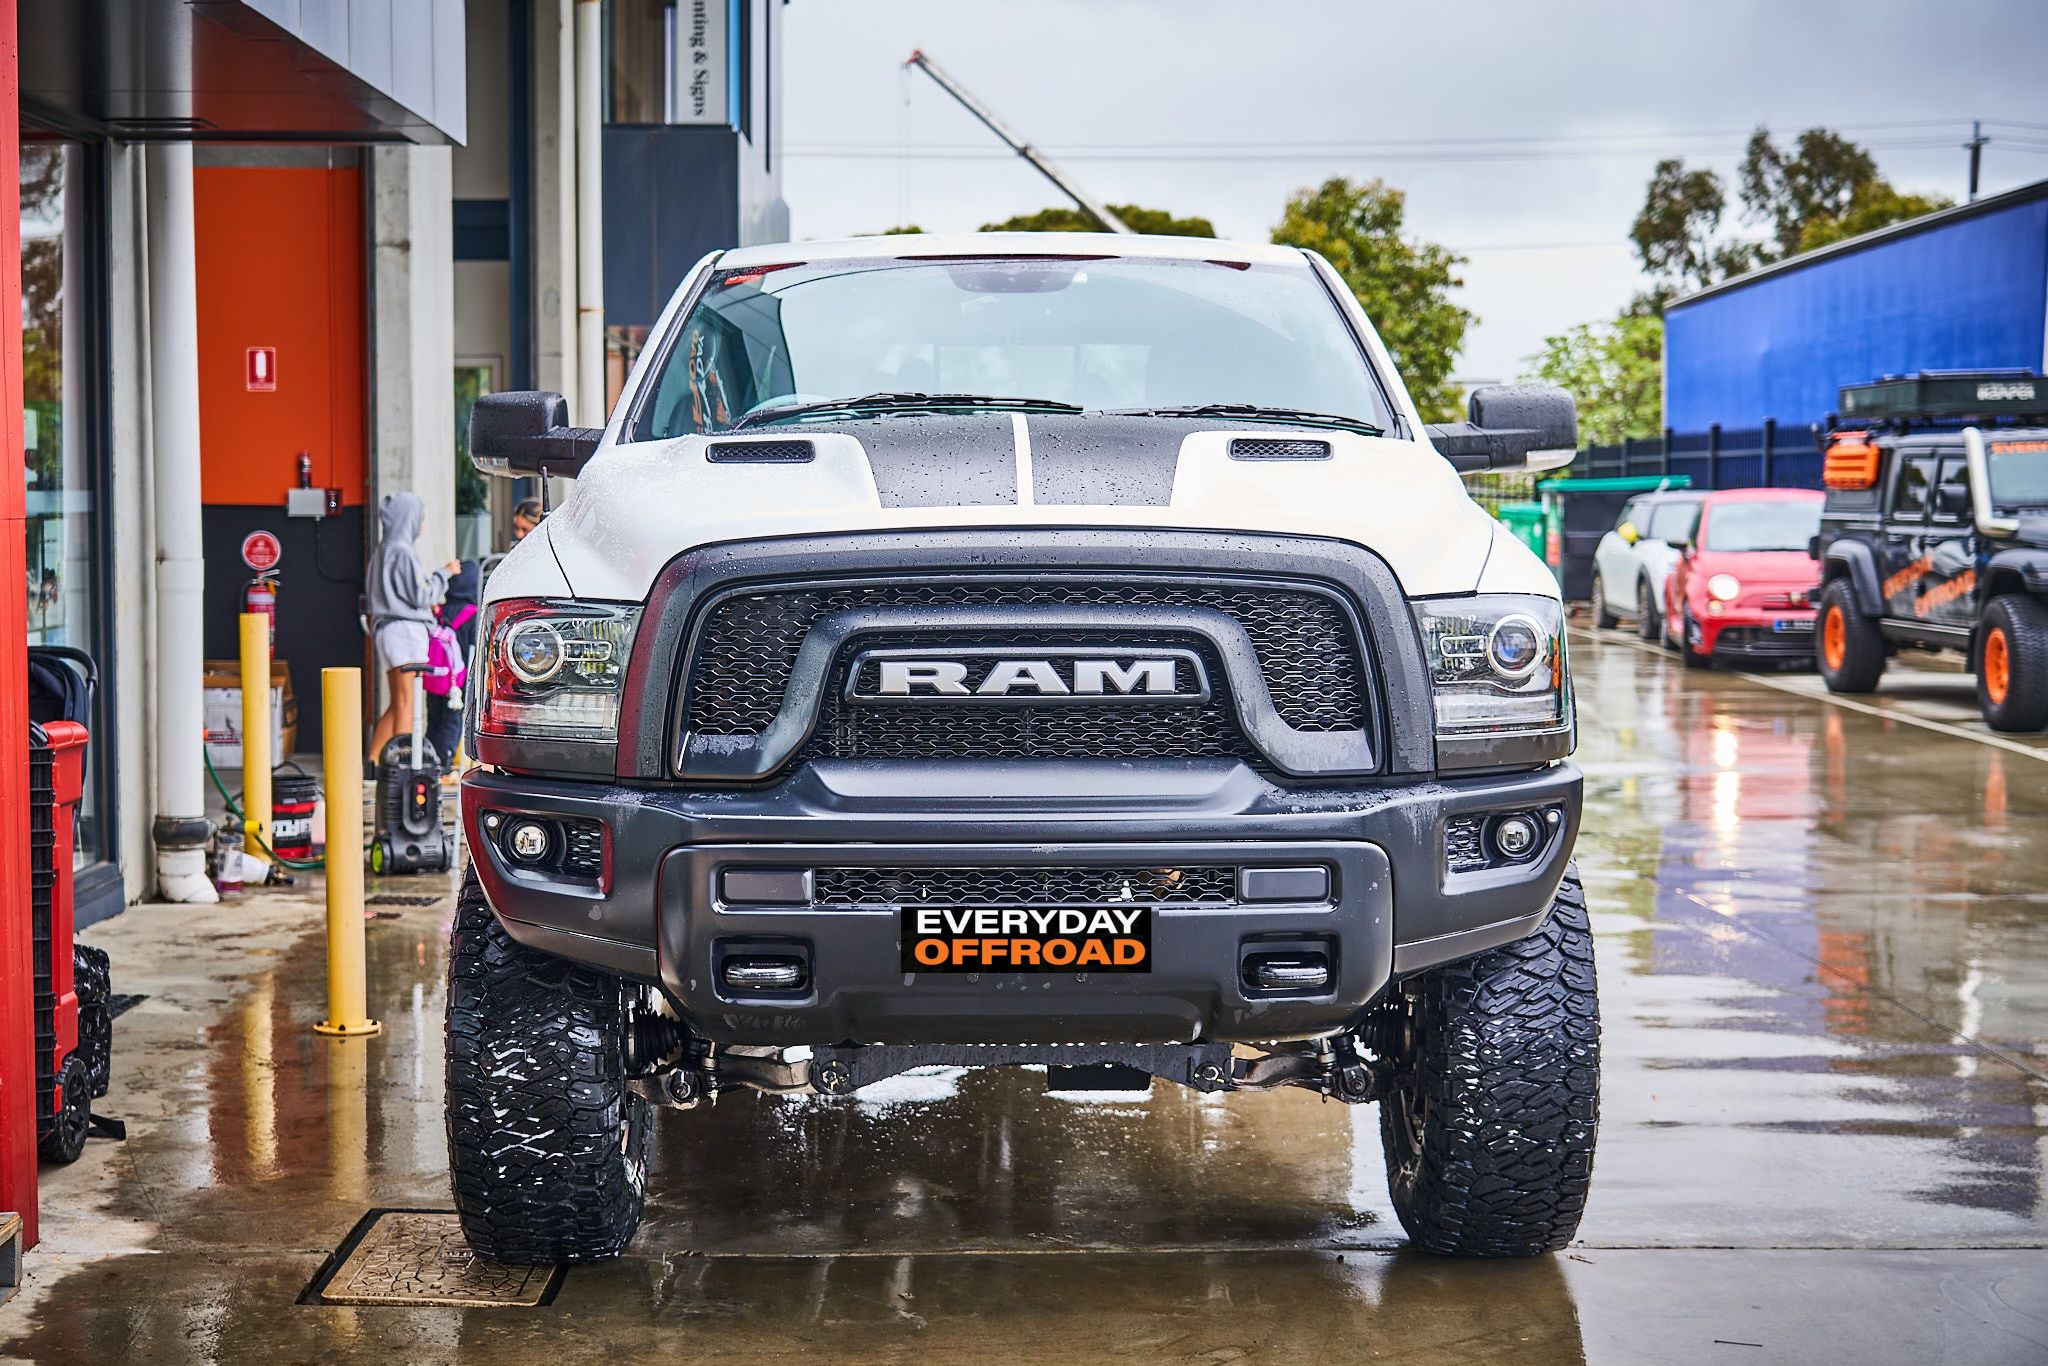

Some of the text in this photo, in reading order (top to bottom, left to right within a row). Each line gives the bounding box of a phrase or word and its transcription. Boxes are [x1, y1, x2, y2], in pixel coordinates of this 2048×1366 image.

[693, 51, 709, 64] &
[688, 69, 710, 116] Signs
[879, 660, 1176, 694] RAM
